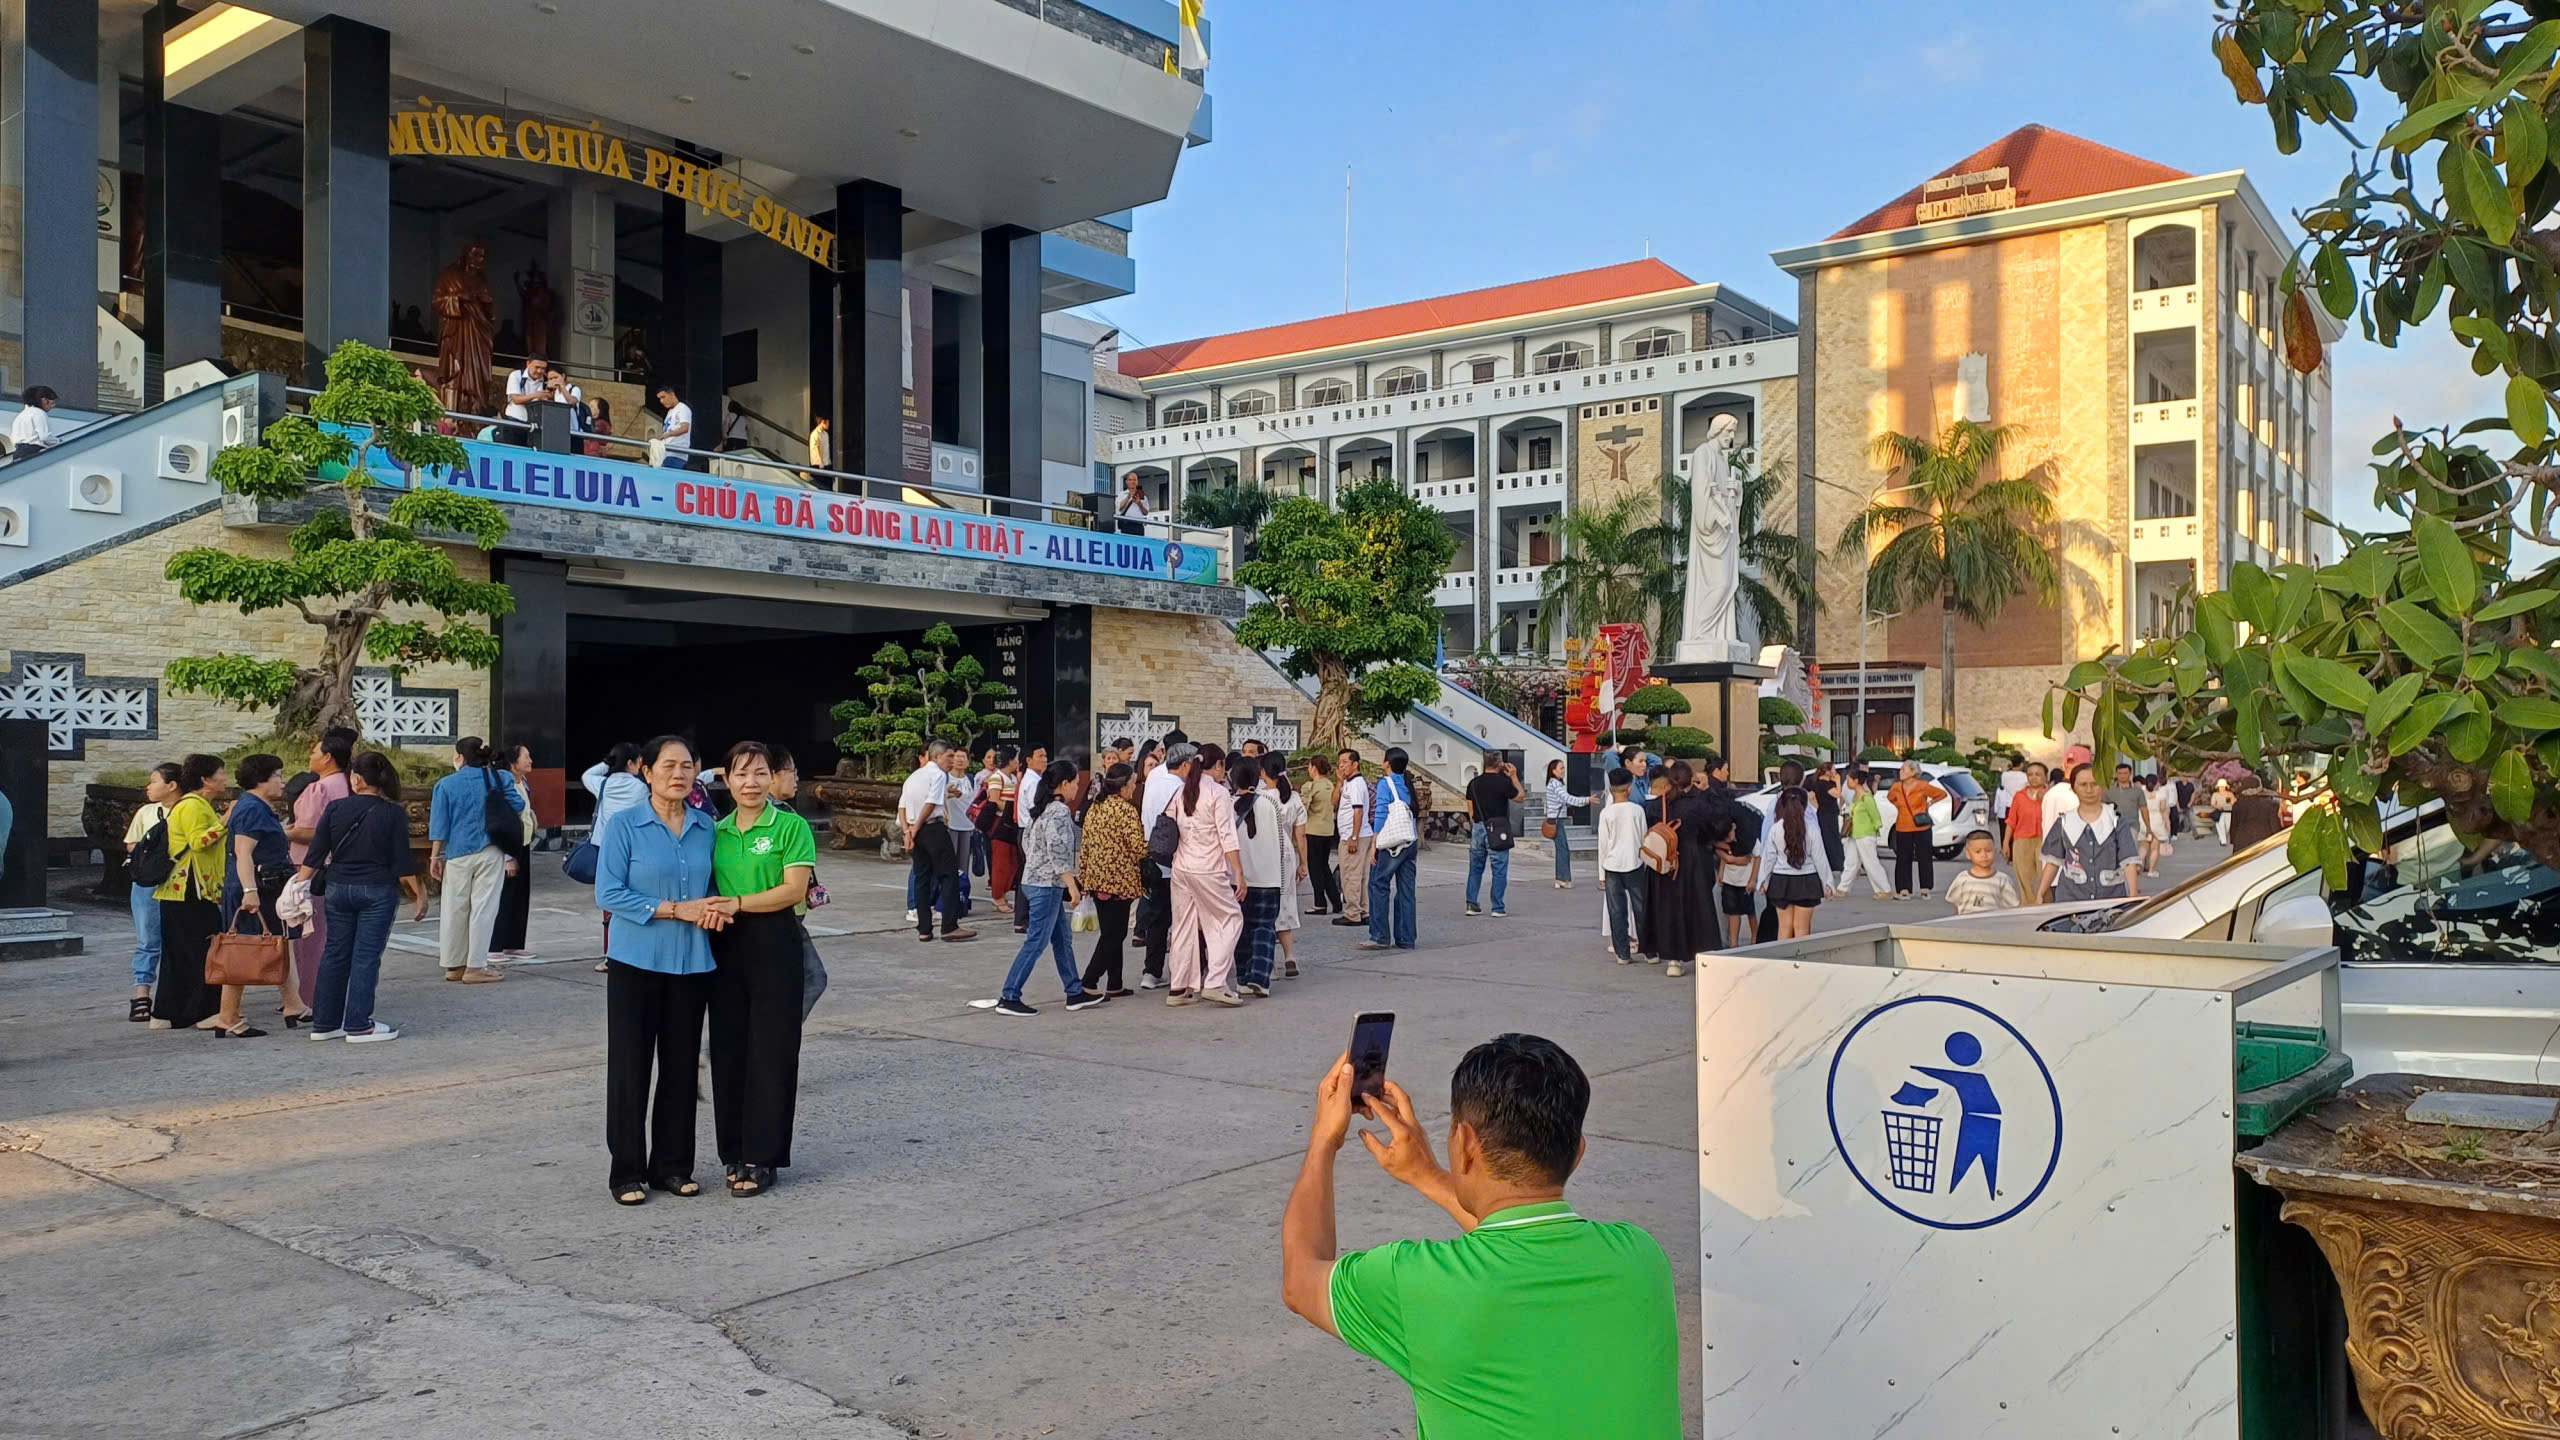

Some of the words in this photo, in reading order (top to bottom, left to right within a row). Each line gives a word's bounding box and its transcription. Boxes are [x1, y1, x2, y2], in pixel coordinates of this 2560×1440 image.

[389, 96, 506, 157] MỪNG
[515, 120, 632, 180] CHÚA
[643, 147, 744, 217] PHỤC
[749, 195, 836, 268] SINH
[447, 453, 640, 508] ALLELUIA
[675, 481, 761, 523] CHÚA
[773, 493, 816, 531] ĐÃ
[827, 498, 902, 541] SỐNG
[911, 514, 953, 554] LẠI
[962, 521, 1025, 561] THẬT
[1045, 534, 1154, 573] ALLELUIA
